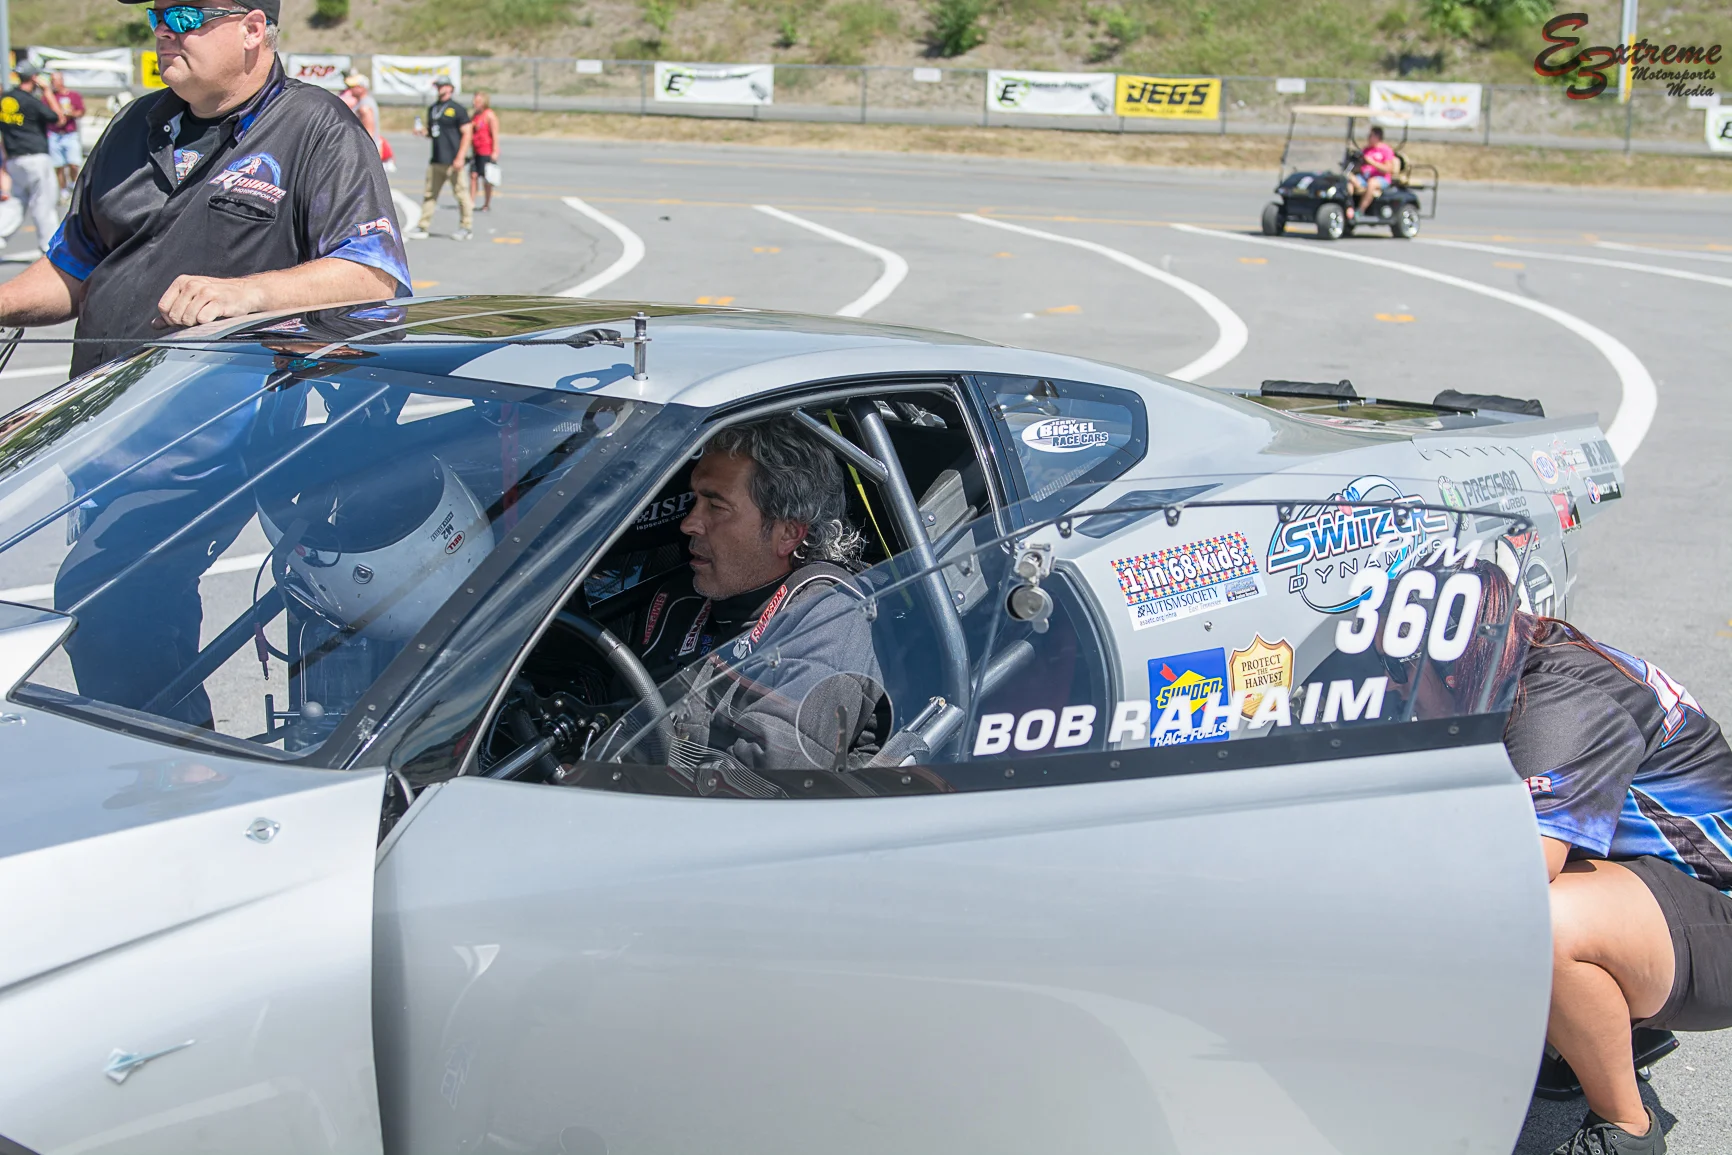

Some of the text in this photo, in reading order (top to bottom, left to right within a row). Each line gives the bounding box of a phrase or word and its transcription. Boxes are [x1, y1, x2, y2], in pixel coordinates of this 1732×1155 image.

[1126, 82, 1210, 105] JEGS
[1040, 422, 1096, 437] BICKEL
[1052, 432, 1109, 447] RACE CARS
[1462, 470, 1523, 506] PRECISION
[1501, 496, 1527, 511] TURBO
[447, 534, 463, 550] BELL
[1267, 495, 1449, 574] SWITZER
[1123, 542, 1250, 593] 1 in 68 kids.
[752, 588, 785, 642] SIMPSON
[1336, 566, 1482, 662] 360
[1242, 653, 1281, 672] PROTECT
[1257, 667, 1269, 675] THE
[1245, 671, 1283, 689] HARVEST
[1160, 679, 1222, 707] SUNOCO
[973, 675, 1389, 756] BOB RAHAIM
